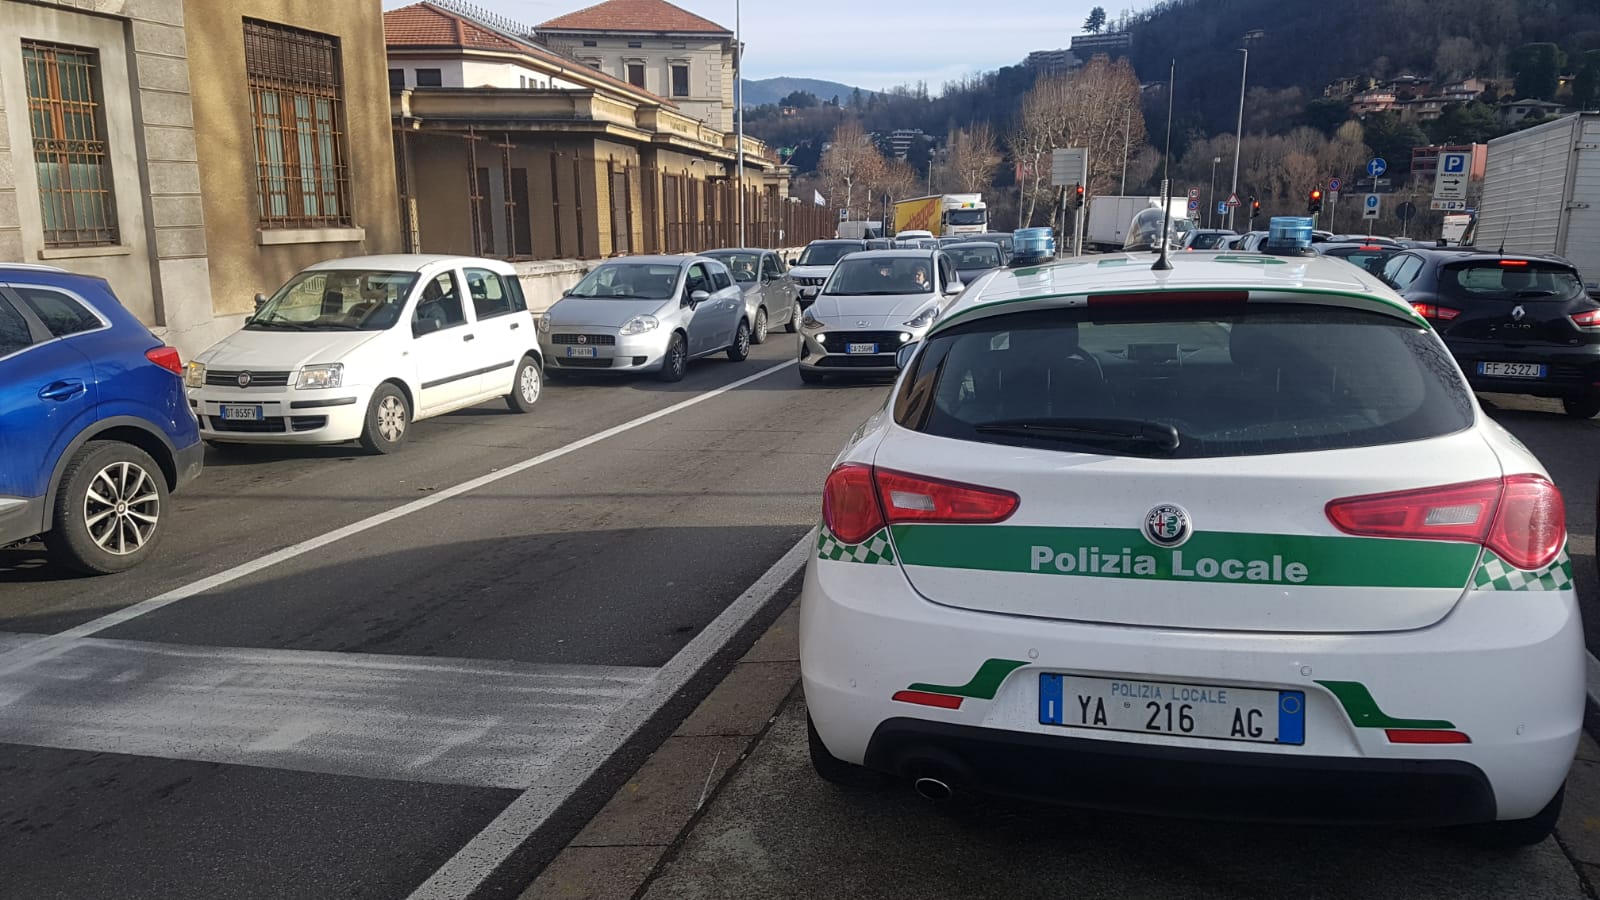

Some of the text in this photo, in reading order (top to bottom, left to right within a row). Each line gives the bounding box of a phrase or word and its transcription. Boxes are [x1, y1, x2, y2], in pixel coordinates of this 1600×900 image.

[1485, 362, 1540, 376] FF 252ZJ
[1030, 545, 1308, 583] Polizia Locale
[1111, 682, 1227, 704] POLIZIA LOCALE
[1078, 695, 1264, 738] YA 216 AG
